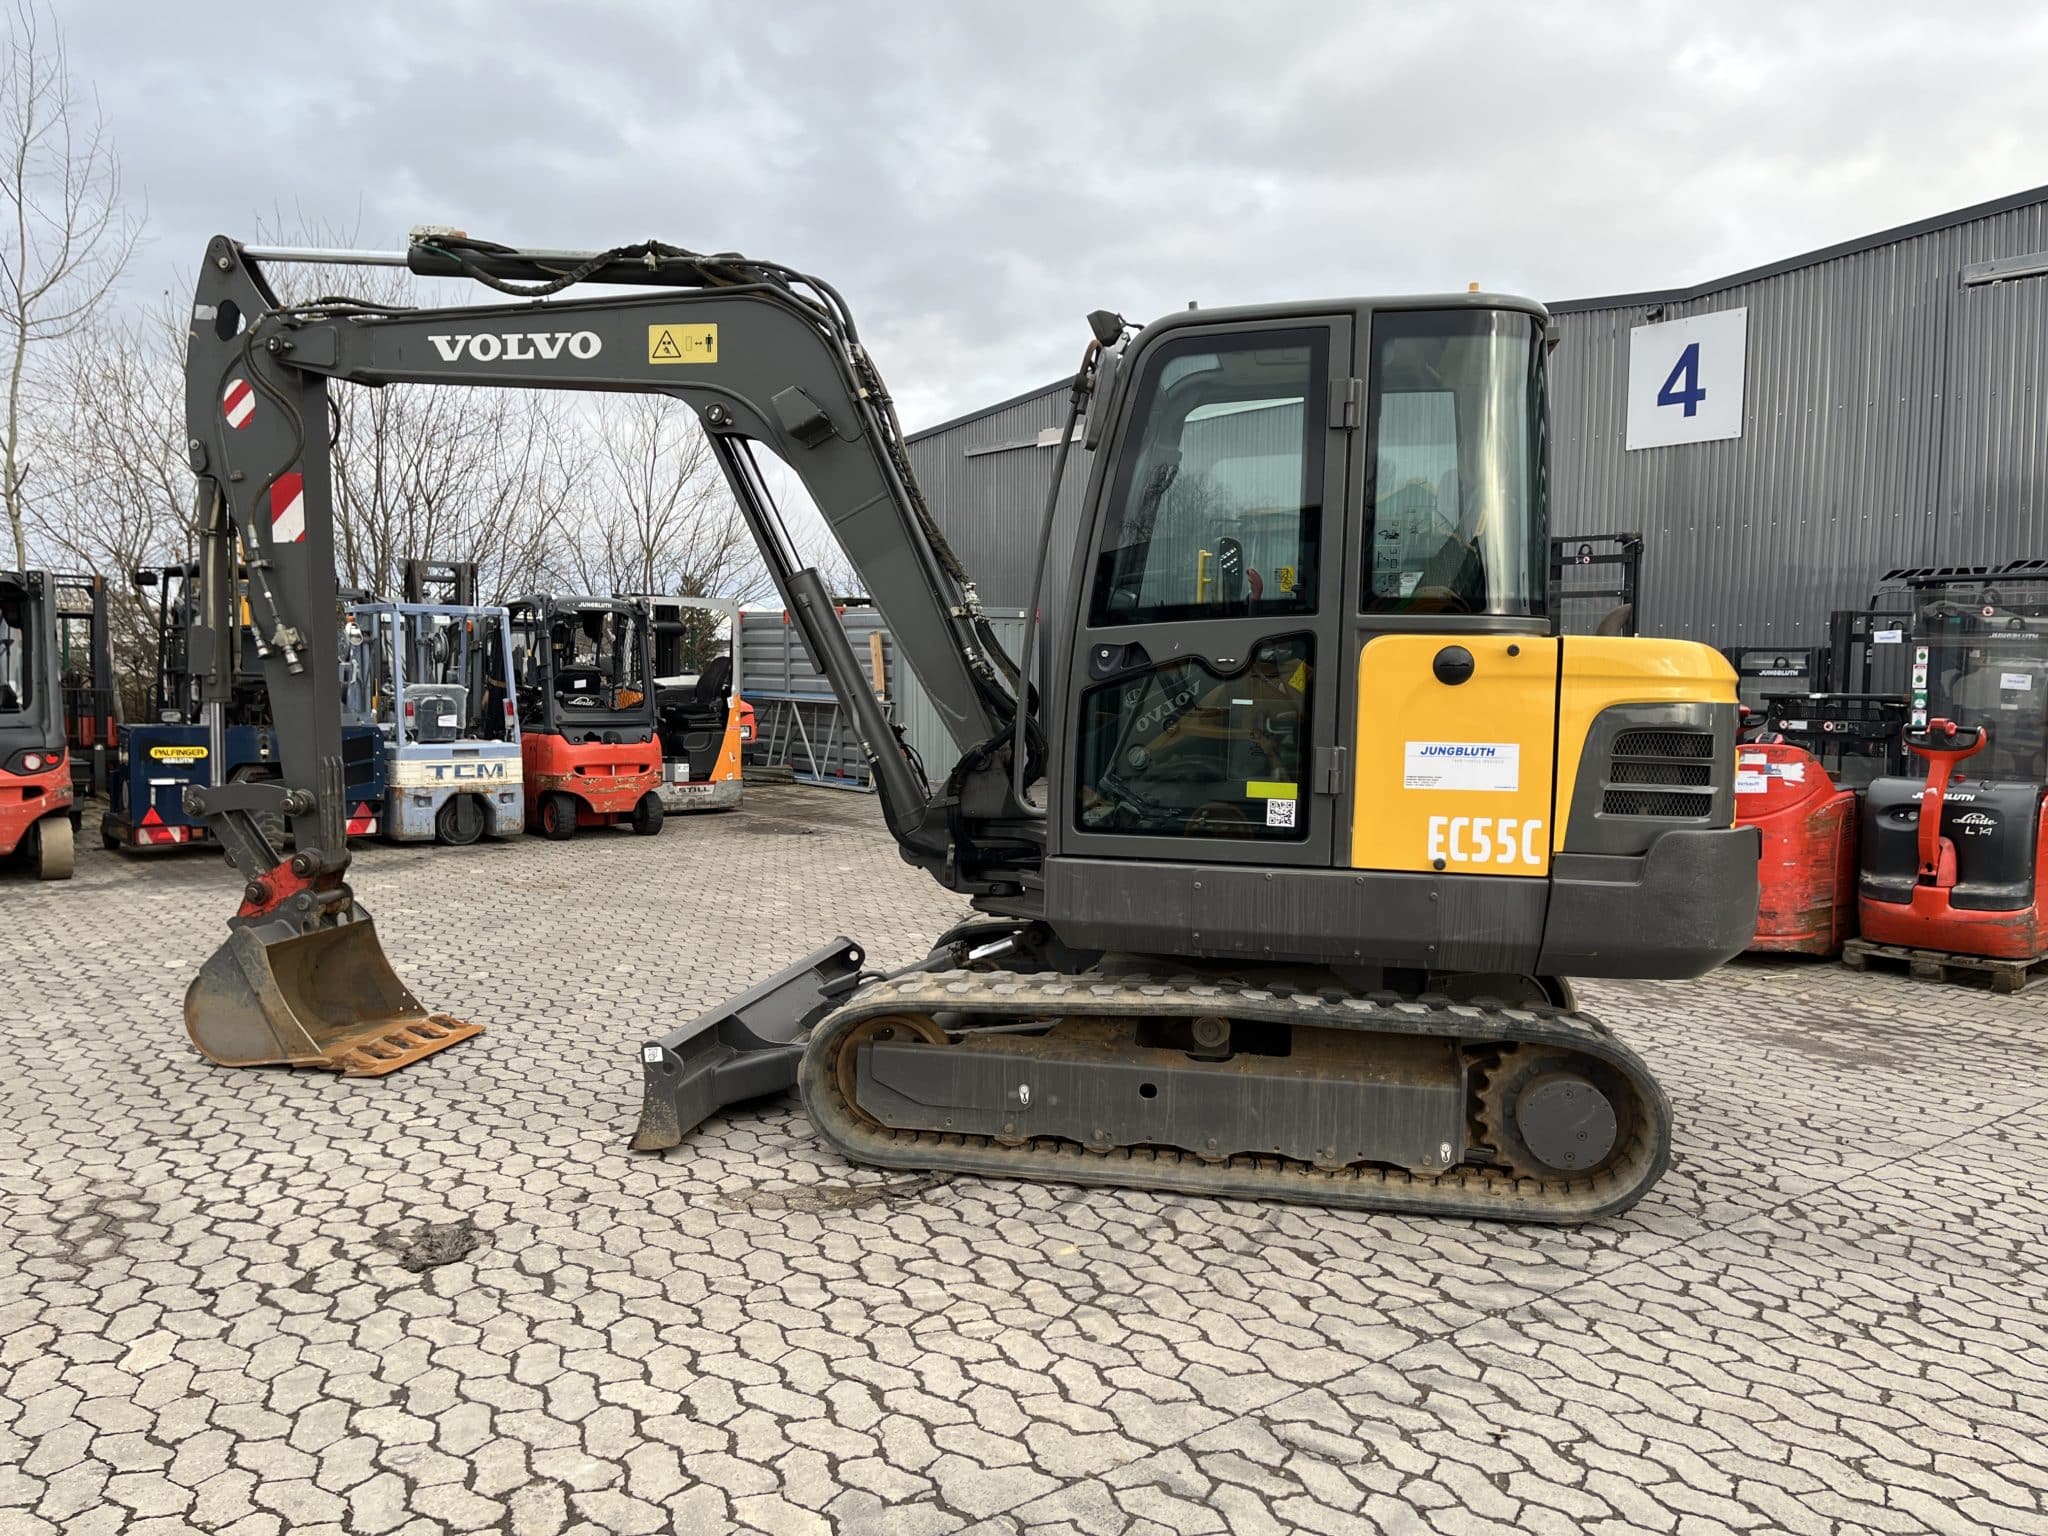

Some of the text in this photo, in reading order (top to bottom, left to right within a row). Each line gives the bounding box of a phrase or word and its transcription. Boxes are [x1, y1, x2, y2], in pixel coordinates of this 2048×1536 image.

[428, 331, 602, 361] VOLVO
[1657, 342, 1706, 417] 4
[154, 749, 204, 757] PALFINGER
[1420, 746, 1496, 757] JUNGBLUTH
[425, 763, 503, 780] TCM
[1952, 812, 1998, 826] Linde
[1965, 826, 1993, 836] L 14
[1428, 816, 1543, 865] EC55C
